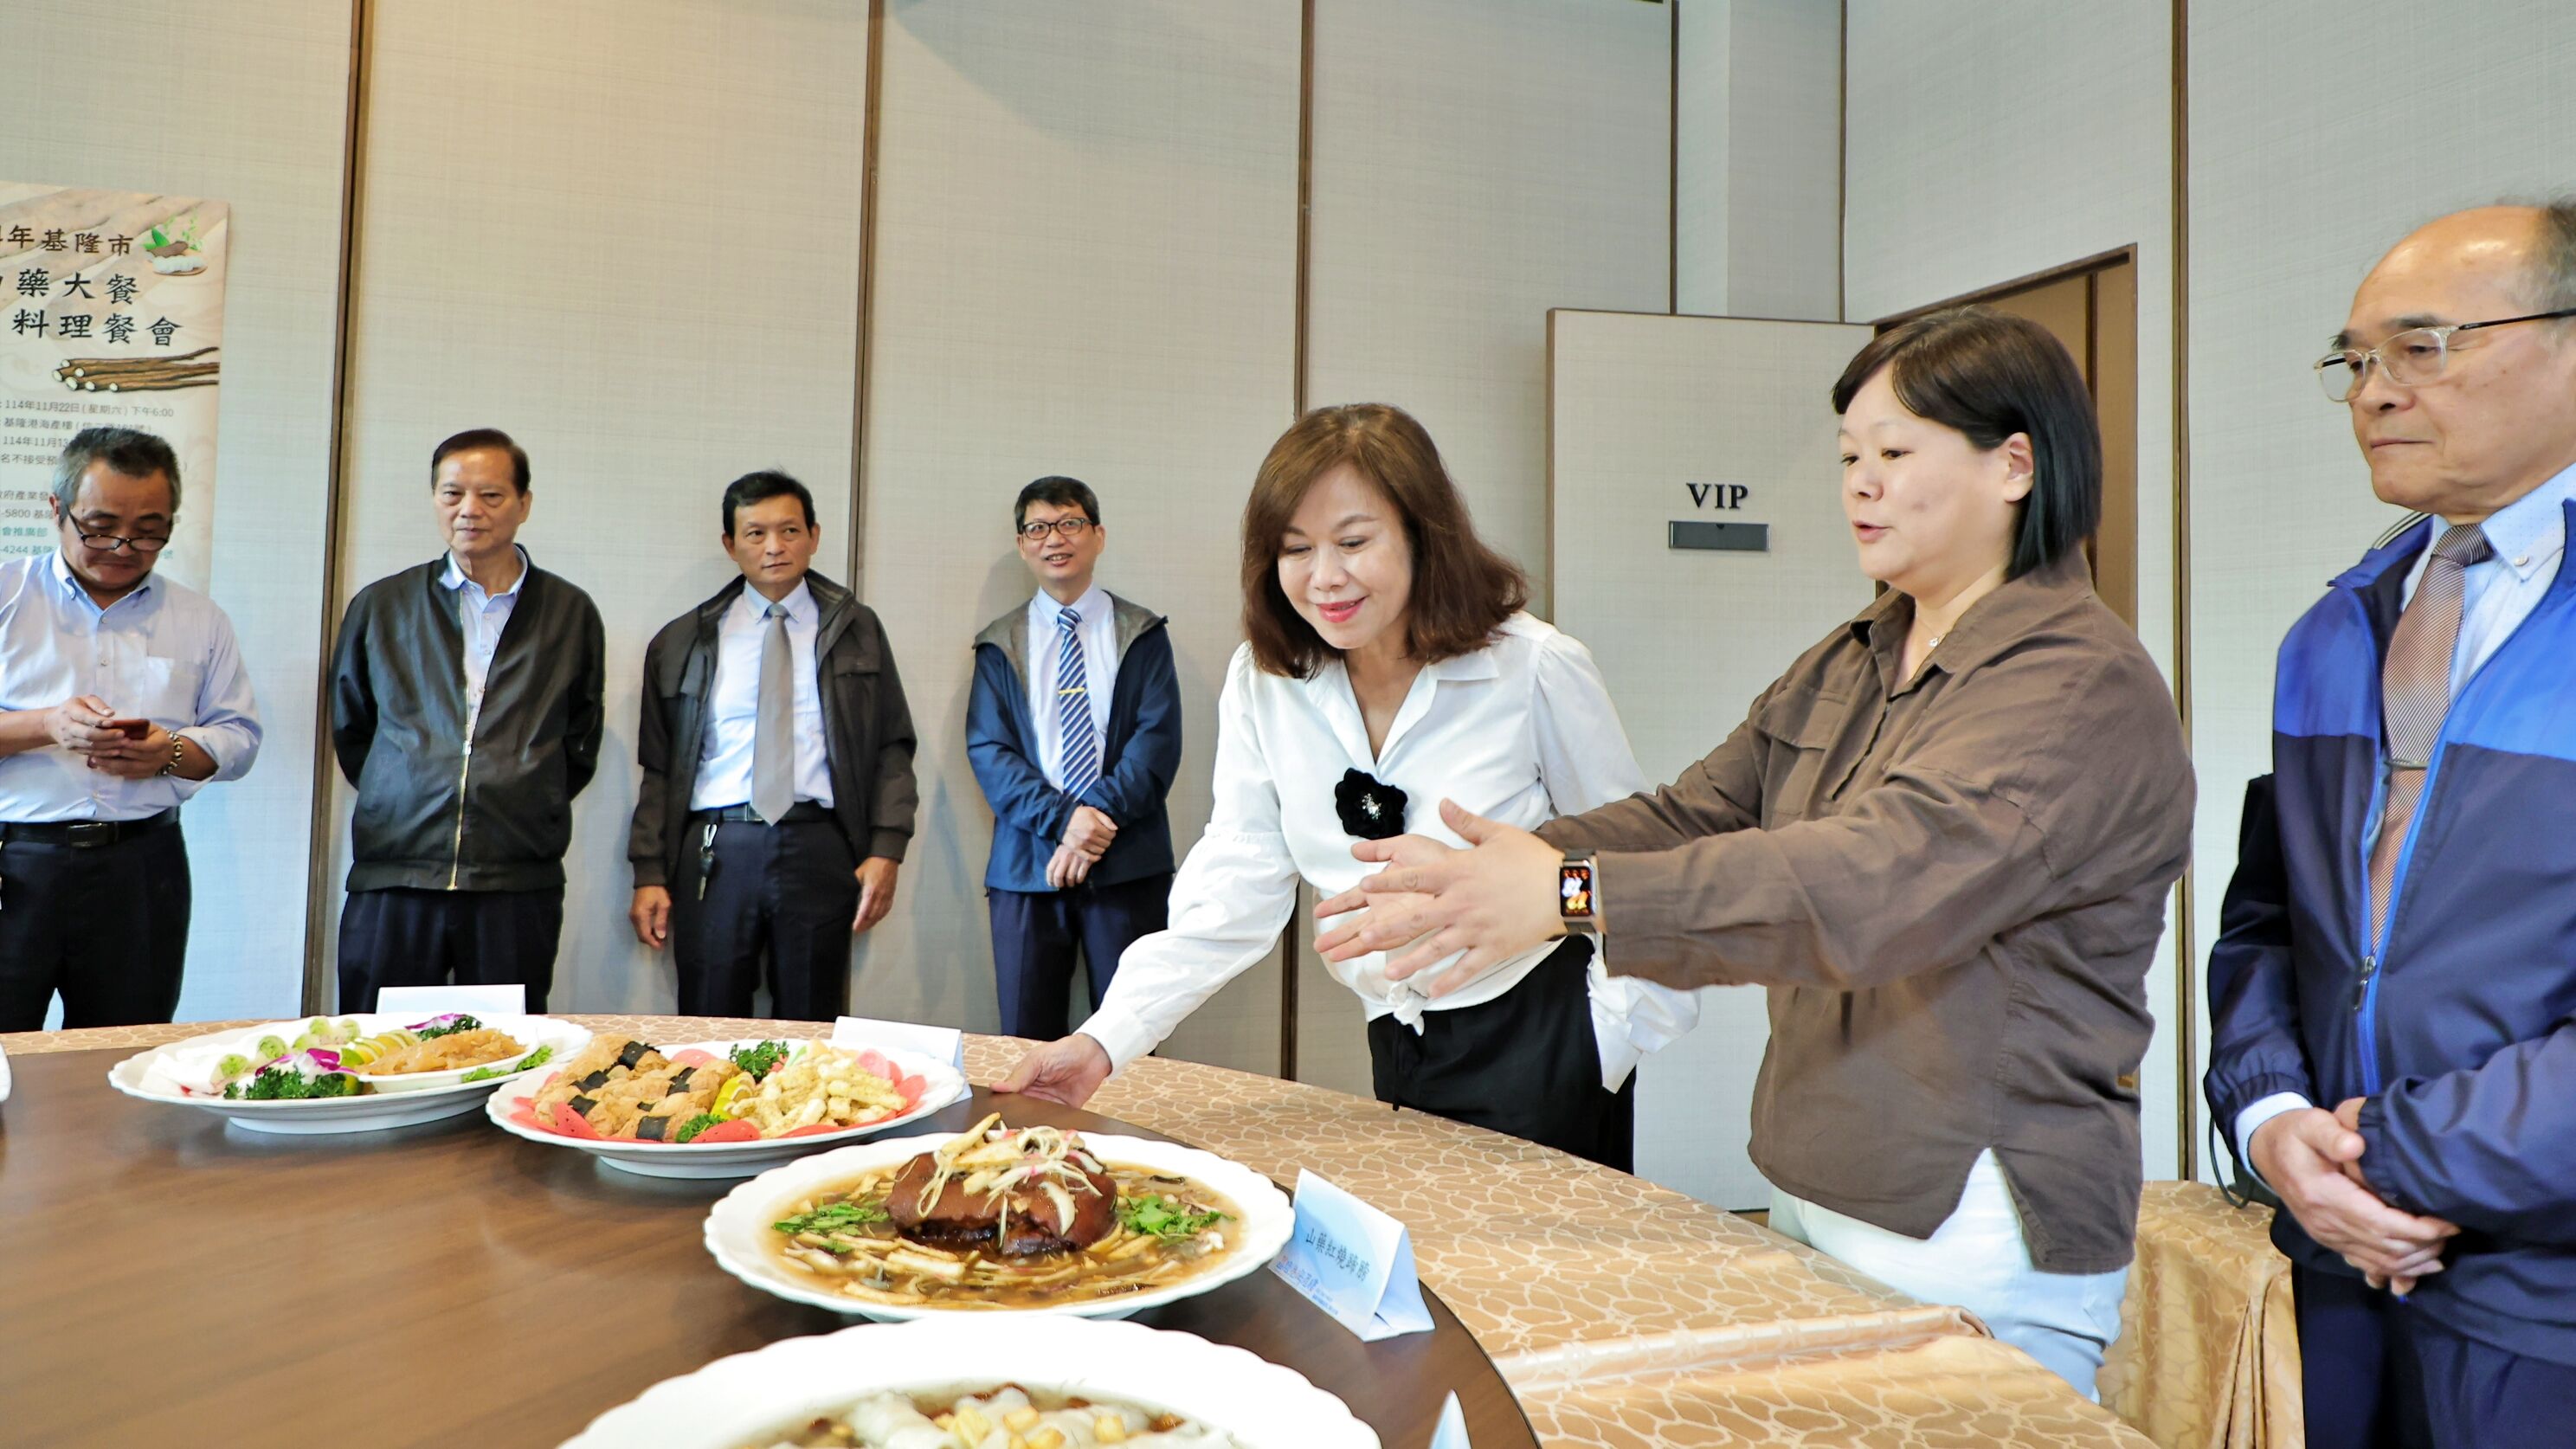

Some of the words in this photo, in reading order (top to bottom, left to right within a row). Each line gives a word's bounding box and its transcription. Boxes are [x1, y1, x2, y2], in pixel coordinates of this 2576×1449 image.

[0, 224, 134, 256] 年基隆市
[0, 267, 140, 305] 藥大餐
[11, 308, 184, 346] 料理餐會
[1686, 482, 1748, 509] VIP
